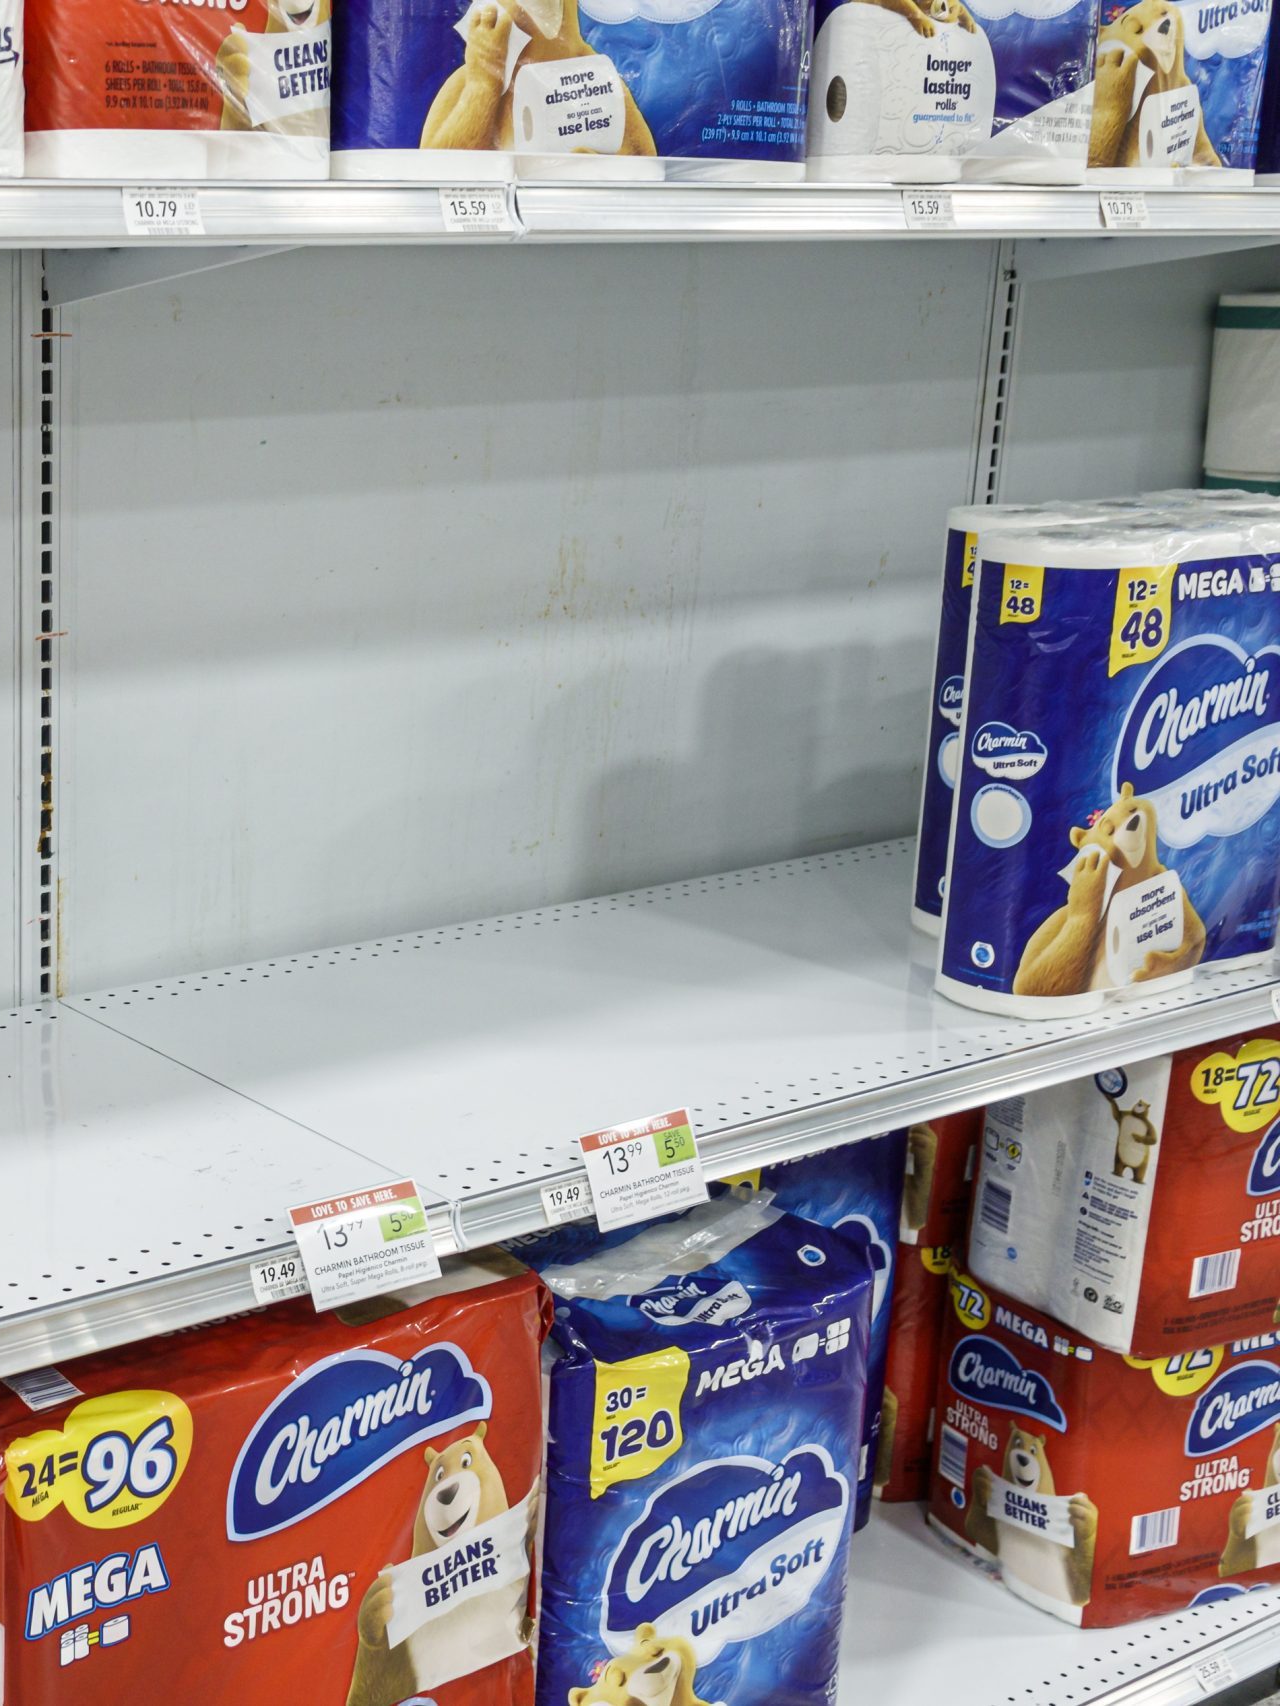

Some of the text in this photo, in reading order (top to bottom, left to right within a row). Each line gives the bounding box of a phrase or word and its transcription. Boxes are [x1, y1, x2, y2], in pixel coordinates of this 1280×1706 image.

[1198, 1, 1238, 33] Ultra
[274, 40, 328, 71] CLEANS
[926, 54, 972, 76] longer
[560, 70, 596, 87] more
[923, 77, 972, 99] lasting
[545, 81, 614, 106] absorbent
[935, 99, 959, 112] rolls
[578, 110, 590, 119] you
[590, 106, 603, 115] can
[912, 114, 963, 124] guaranteed to
[557, 120, 583, 137] use
[135, 200, 177, 218] 10.79
[449, 200, 486, 216] 15.59
[911, 200, 939, 215] 15.59
[1107, 201, 1133, 215] 10.79
[1178, 566, 1244, 601] MEGA
[1005, 595, 1035, 616] 48
[1120, 607, 1163, 650] 48
[1134, 658, 1270, 770] Charmin
[977, 732, 1028, 752] Charmin
[993, 758, 1038, 770] Ultra Soft
[1180, 769, 1238, 820] Ultra
[1129, 891, 1176, 921] absorbent
[1141, 885, 1165, 903] more
[1136, 929, 1153, 944] use
[1233, 1056, 1280, 1111] 72
[598, 1132, 619, 1146] LOVE
[663, 1129, 681, 1139] SAVE
[599, 1165, 696, 1200] CHARMIN BATHROOM TISSUE
[620, 1181, 680, 1202] Papel Charmin
[311, 1189, 397, 1219] LOVE TO SAVE HERE.
[549, 1186, 580, 1207] 19.49
[610, 1204, 623, 1214] Ultra
[314, 1239, 426, 1277] CHARMIN BATHROOM TISSUE
[337, 1256, 408, 1280] Papel Charmin
[260, 1261, 296, 1285] 19.49
[321, 1270, 384, 1294] Ultra Super Mega
[693, 1301, 722, 1323] Ultra
[958, 1283, 984, 1320] 72
[995, 1307, 1048, 1348] MEGA
[696, 1340, 786, 1398] MEGA
[958, 1351, 1038, 1406] Charmin
[956, 1398, 990, 1429] ULTRA
[255, 1359, 432, 1506] Charmin
[600, 1409, 674, 1462] 120
[946, 1407, 999, 1451] STRONG
[82, 1416, 178, 1513] 96
[1194, 1456, 1239, 1479] ULTRA
[31, 1490, 50, 1508] MEGA
[1004, 1490, 1048, 1517] CLEANS
[625, 1465, 803, 1604] Charmin
[421, 1537, 494, 1586] CLEANS
[25, 1542, 171, 1641] MEGA
[247, 1556, 326, 1606] ULTRA
[690, 1538, 825, 1638] Ultra Soft
